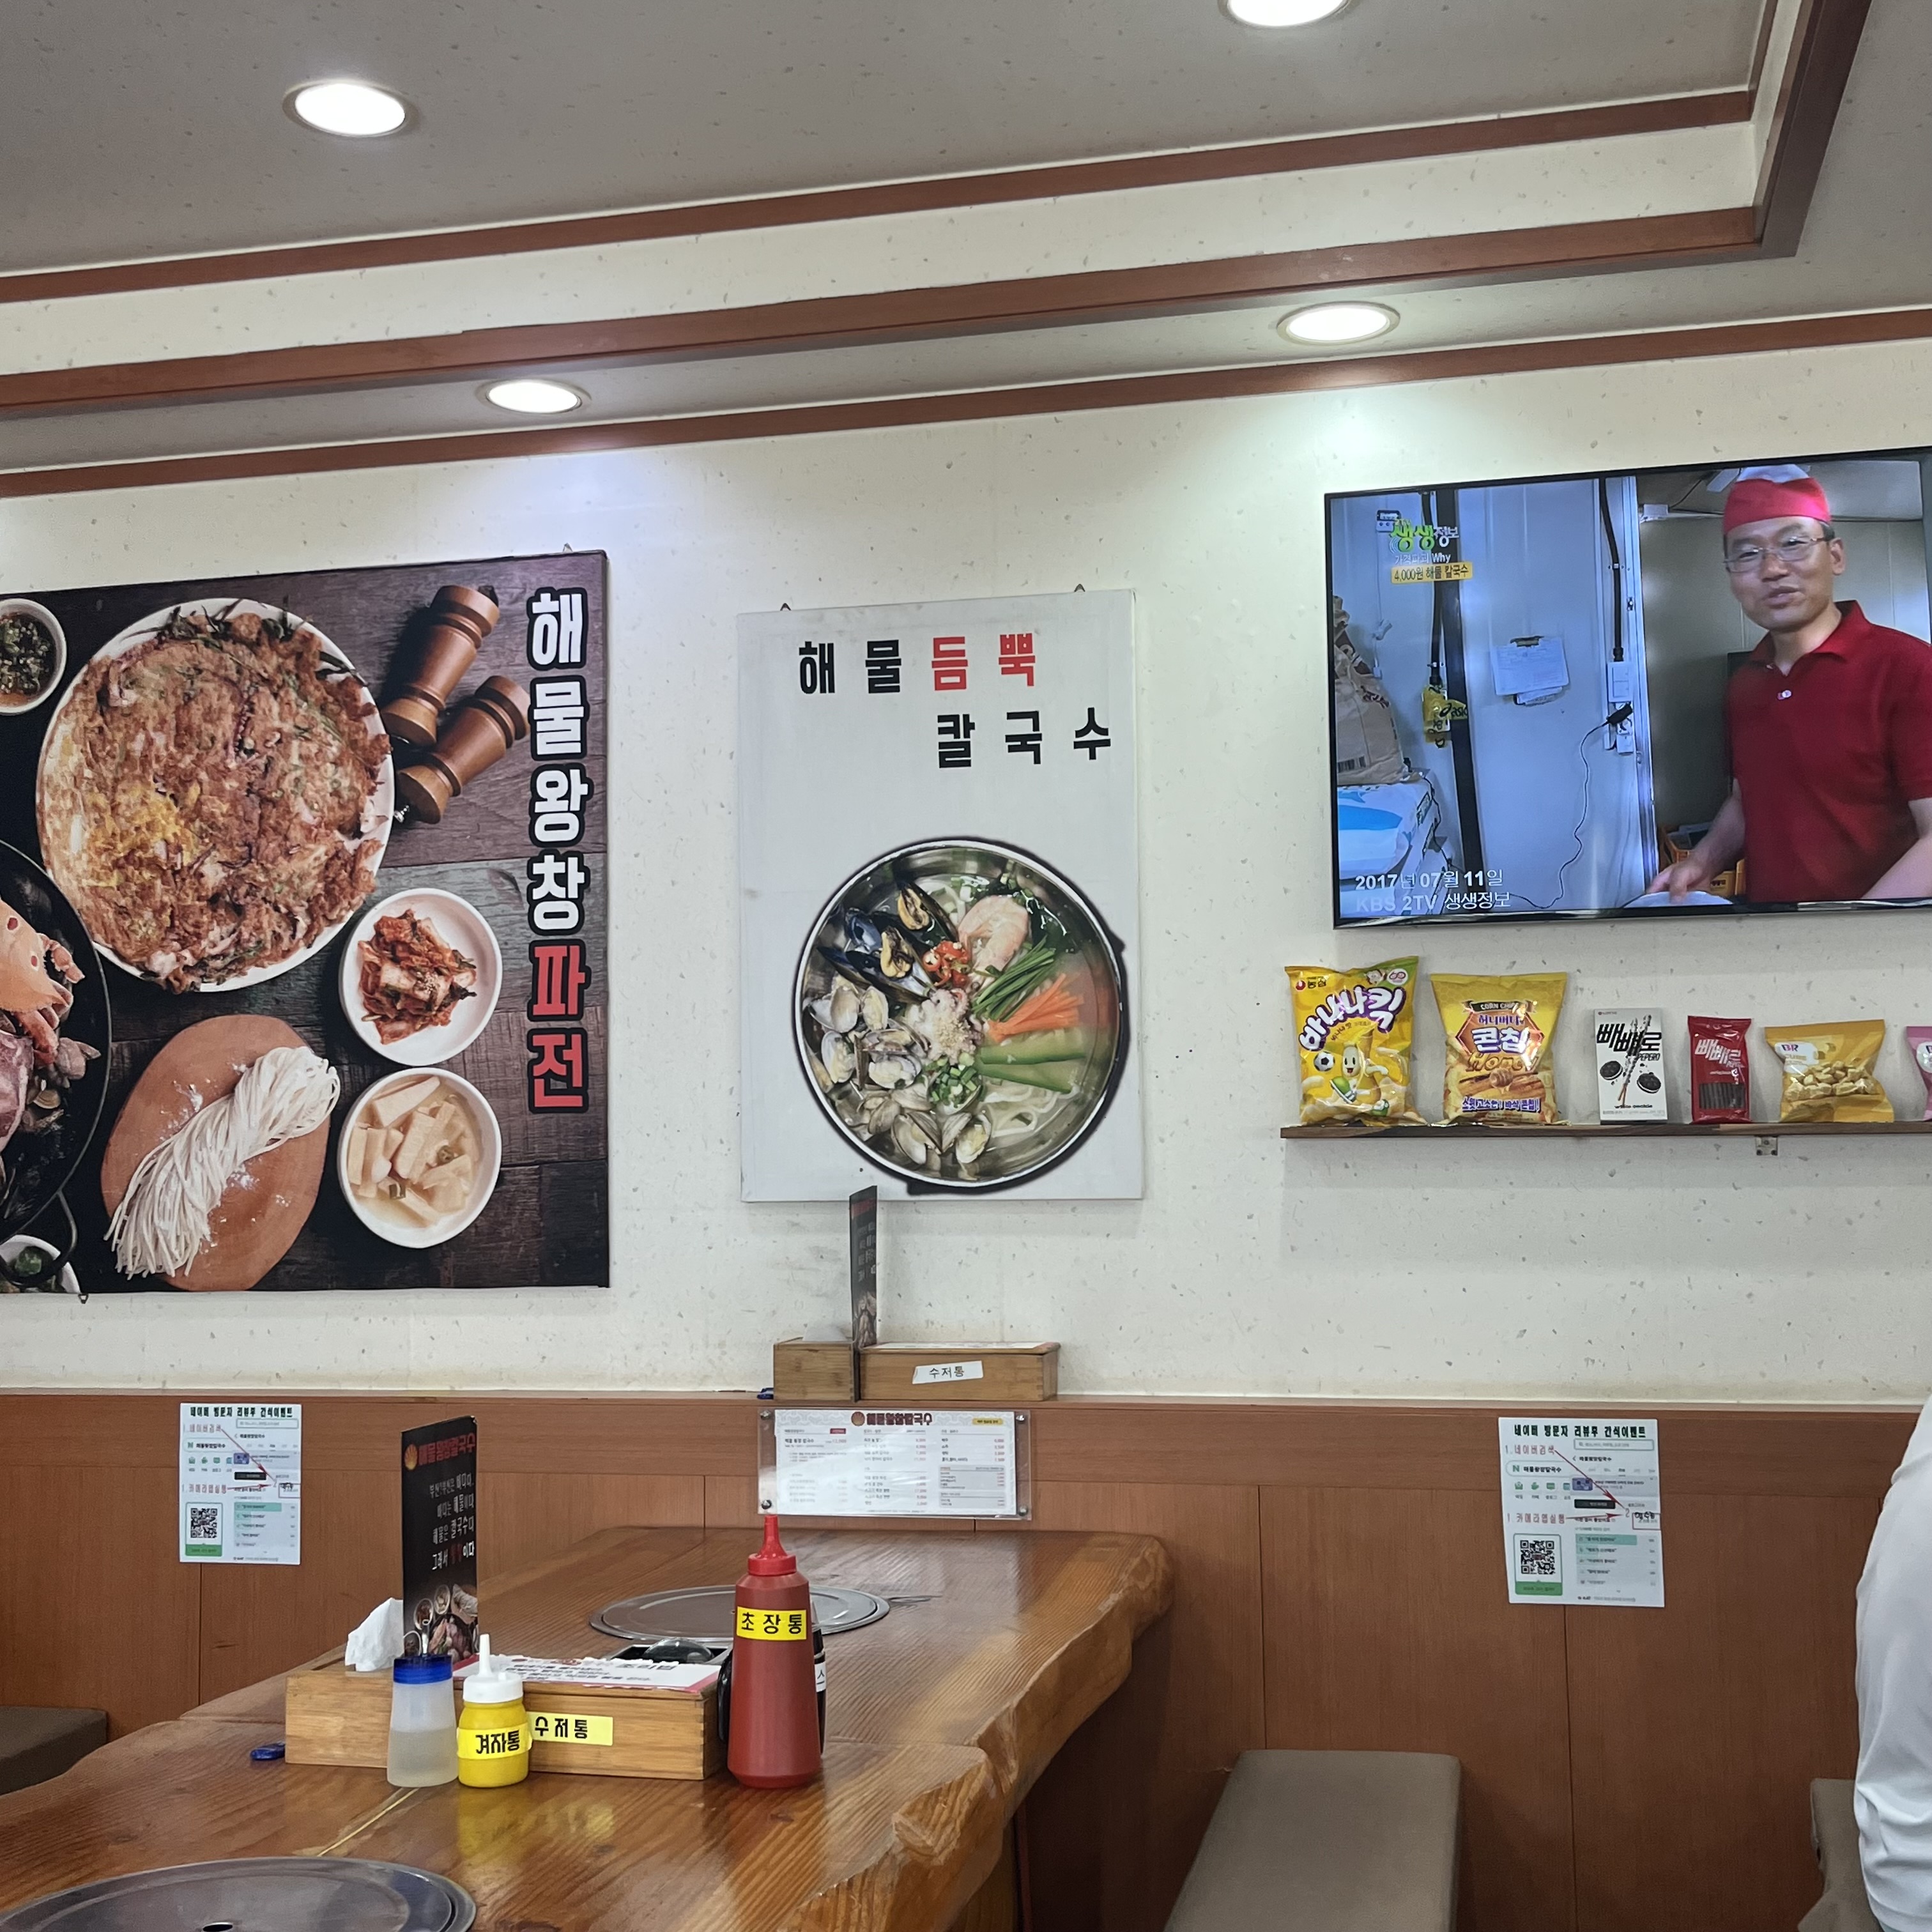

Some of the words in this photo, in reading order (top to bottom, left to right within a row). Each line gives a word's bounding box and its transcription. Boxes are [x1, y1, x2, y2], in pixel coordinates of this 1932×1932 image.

[1432, 552, 1452, 564] Why
[1394, 567, 1424, 582] 4,000원
[1425, 565, 1442, 579] 해물
[1445, 564, 1469, 579] 칼국수
[529, 589, 592, 1110] 해물왕창파전
[1355, 873, 1416, 890] 2017년
[1420, 871, 1459, 888] 07월
[1463, 870, 1503, 887] 11일
[1356, 900, 1396, 912] KBS
[1402, 895, 1437, 910] 2TV
[1445, 892, 1511, 910] 생생정보
[1299, 985, 1407, 1052] 바나나킥
[1597, 1023, 1662, 1052] 빼빼로
[1782, 1044, 1799, 1052] BR
[929, 1365, 965, 1379] 수저통
[1514, 1424, 1538, 1437] 네이버
[1544, 1425, 1568, 1438] 방문자
[741, 1612, 802, 1634] 초장통
[535, 1716, 588, 1739] 수저통
[475, 1729, 520, 1754] 겨자통
